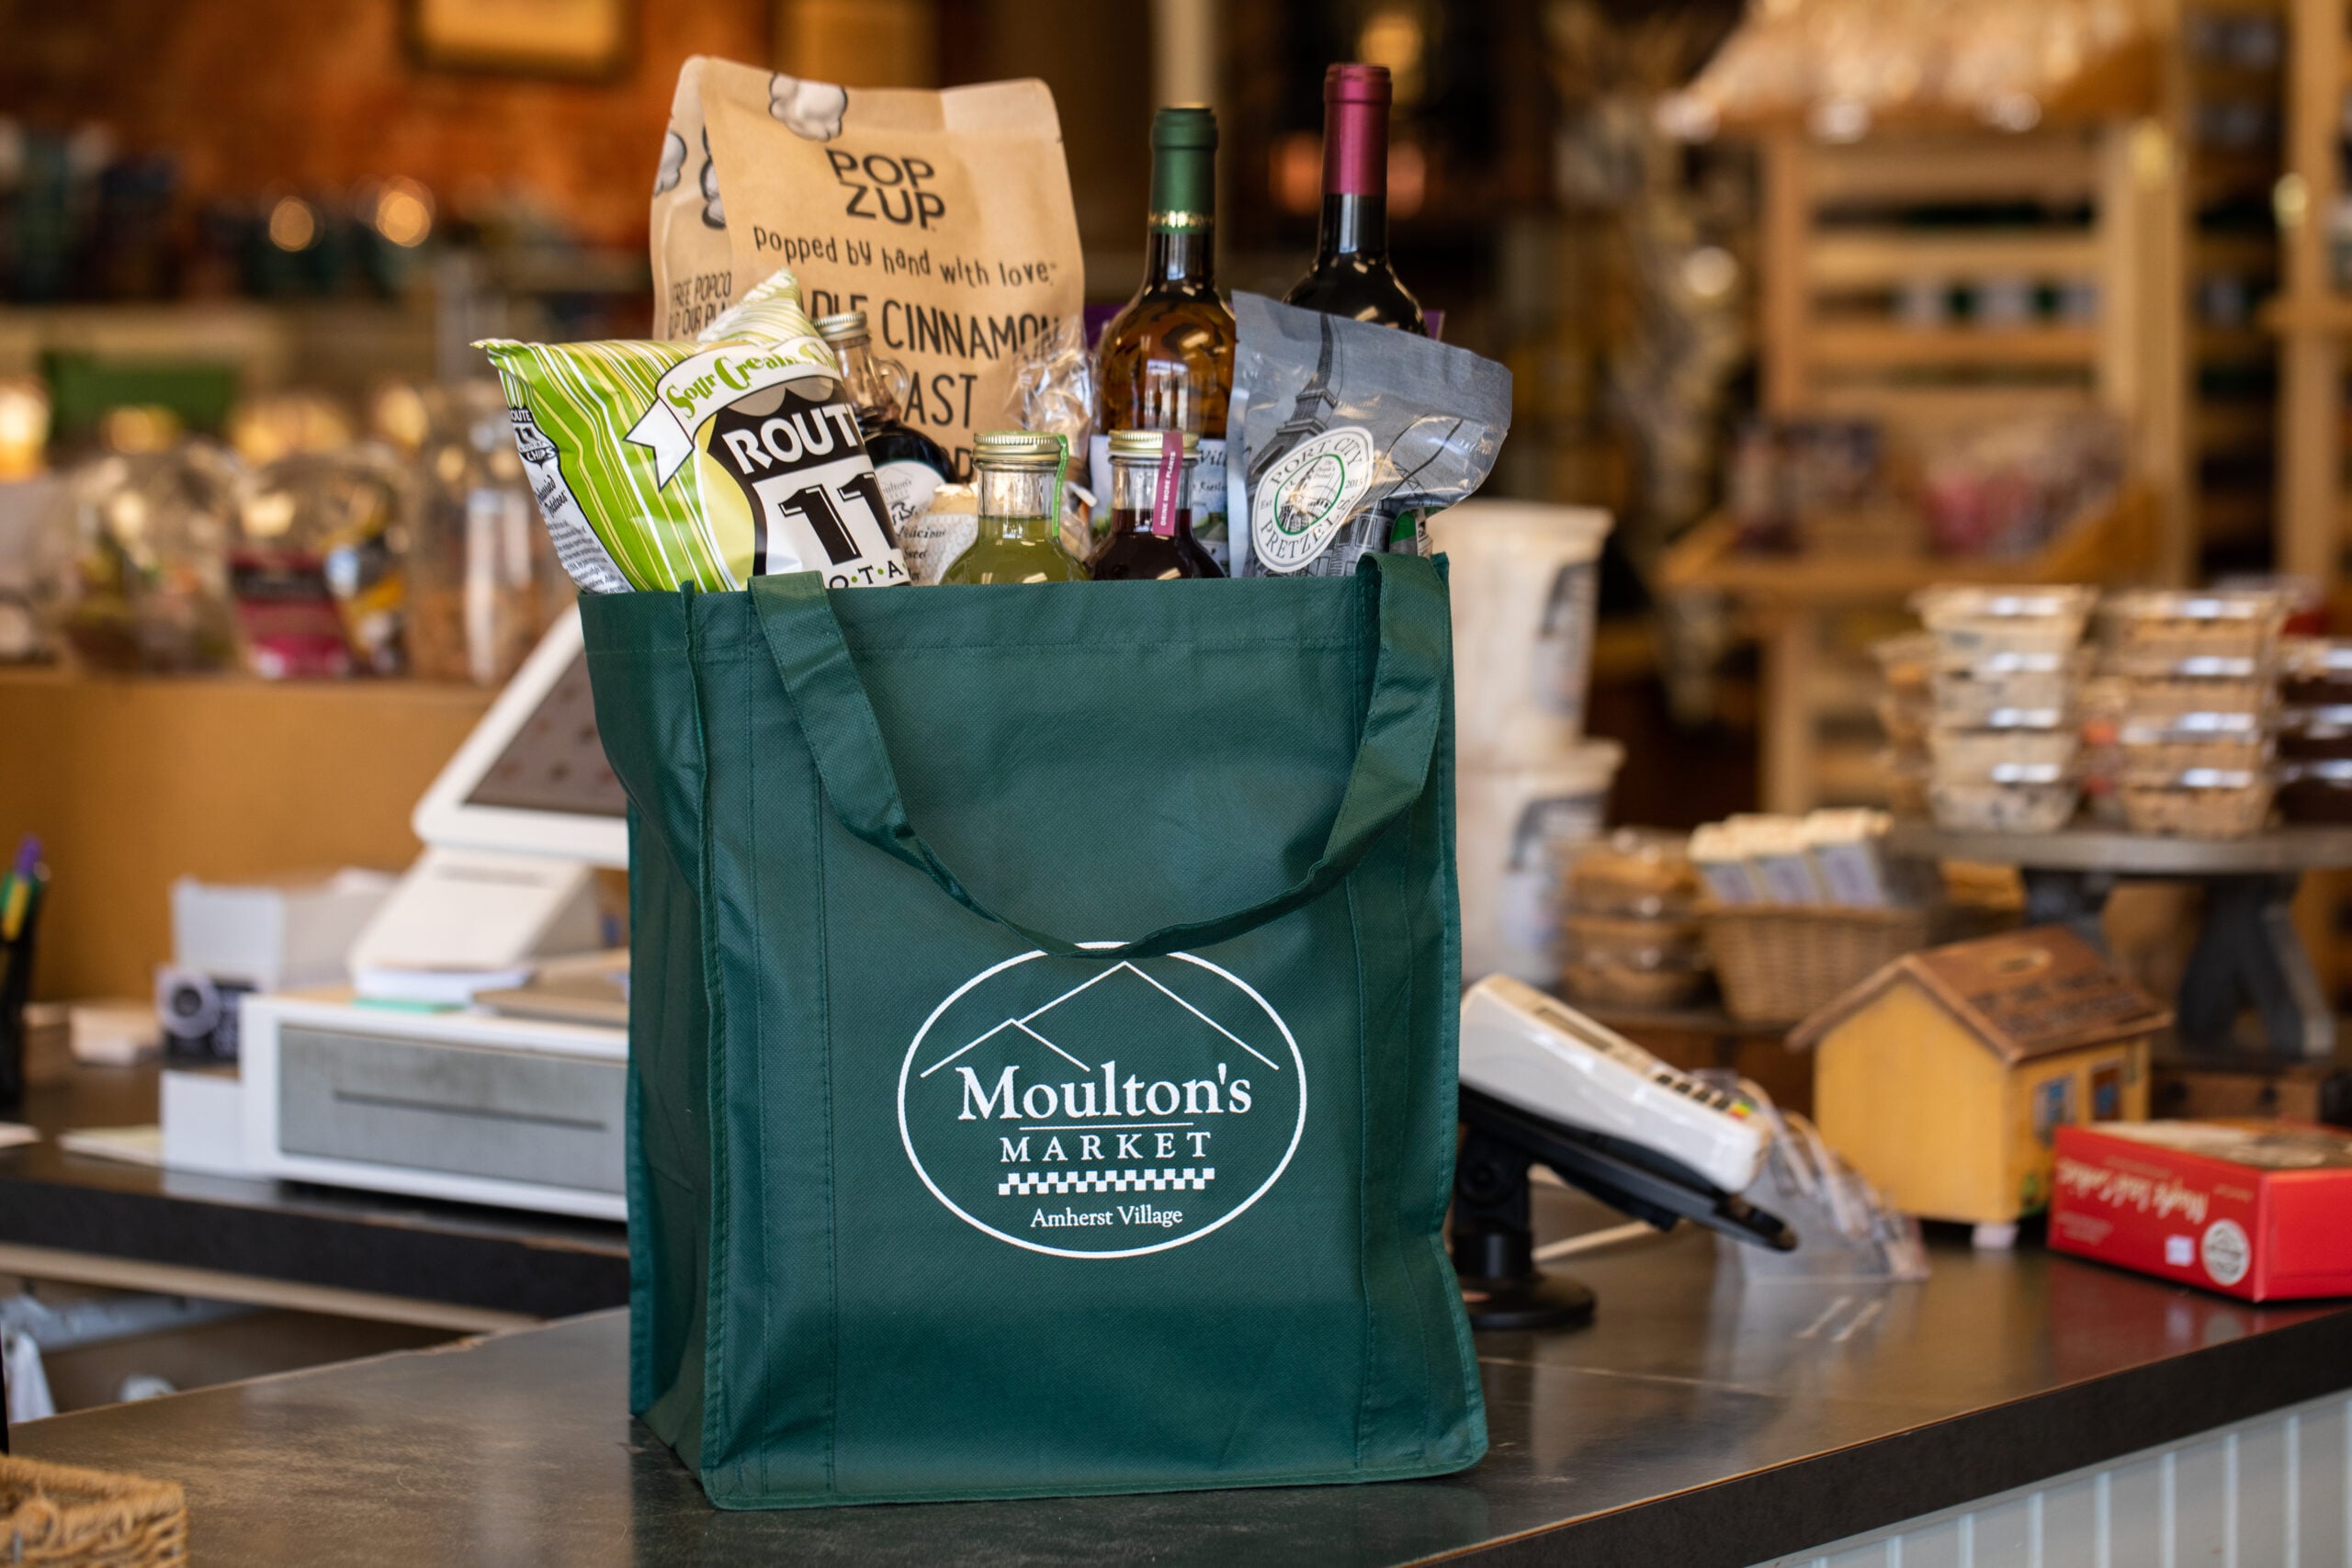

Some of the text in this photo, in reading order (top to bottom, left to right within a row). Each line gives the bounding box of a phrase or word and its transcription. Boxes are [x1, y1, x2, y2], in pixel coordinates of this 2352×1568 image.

[825, 148, 935, 188] POP
[839, 180, 945, 231] ZUP
[753, 226, 838, 265] popped
[846, 239, 872, 265] by
[881, 248, 931, 276] hand
[939, 256, 989, 288] with
[666, 373, 717, 420] Sour
[526, 446, 559, 462] CHIPS
[721, 402, 865, 475] ROUT
[1270, 437, 1363, 485] PORT CITY
[1159, 451, 1176, 526] DRINK MORE PLANTS
[1345, 477, 1363, 490] 2015
[778, 472, 899, 566] 11
[1261, 498, 1351, 559] PRETZELS
[956, 1061, 1252, 1121] Moulton's
[1000, 1132, 1211, 1163] MARKET
[1031, 1203, 1183, 1228] Amherst Village
